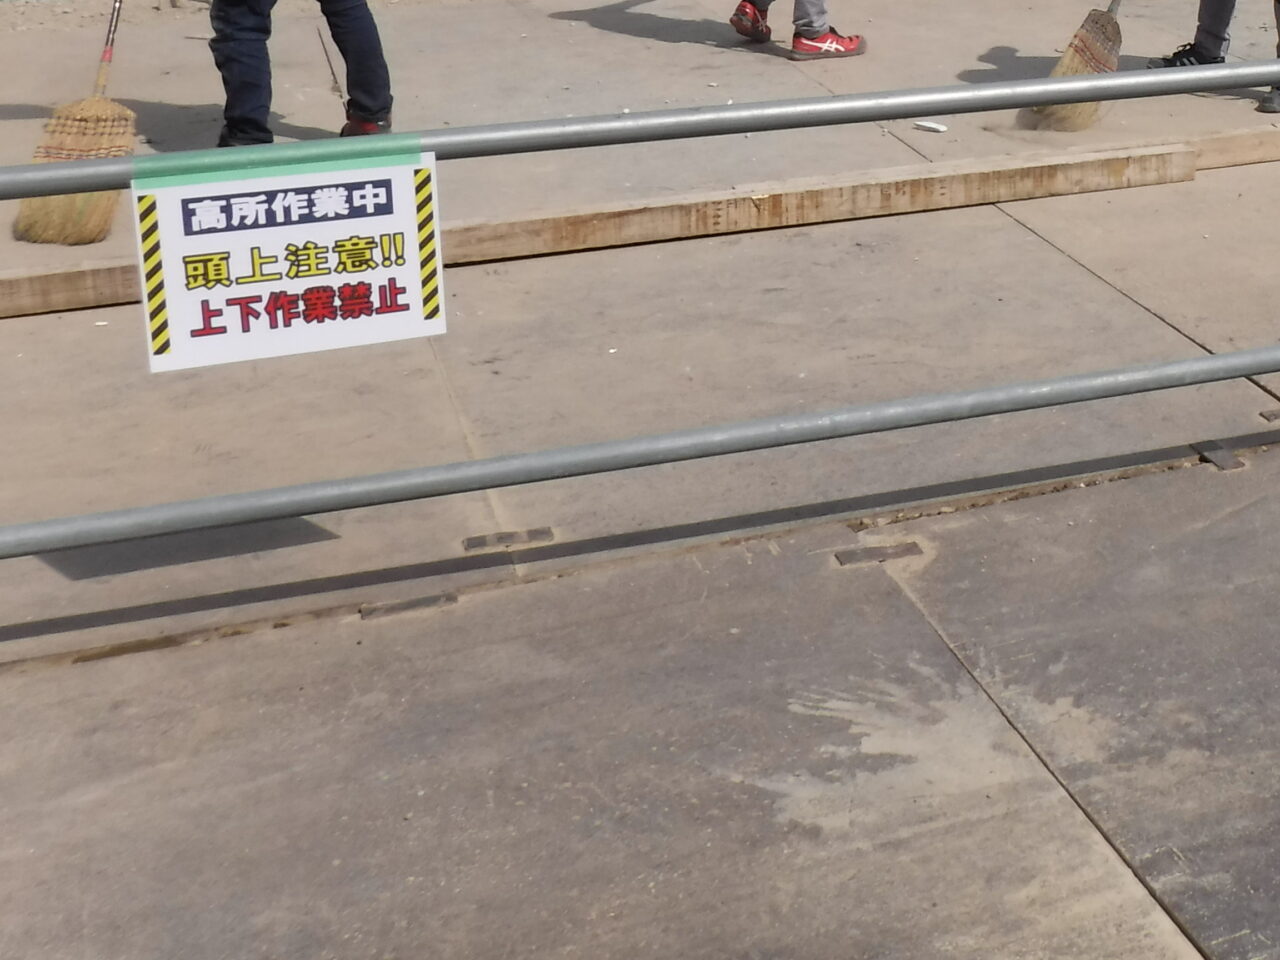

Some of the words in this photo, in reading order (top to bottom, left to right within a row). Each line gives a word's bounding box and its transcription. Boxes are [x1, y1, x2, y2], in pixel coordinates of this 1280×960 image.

[188, 184, 387, 231] 高所作業中
[183, 232, 406, 291] 頭上注意!!
[190, 278, 410, 338] 上下作業禁止
